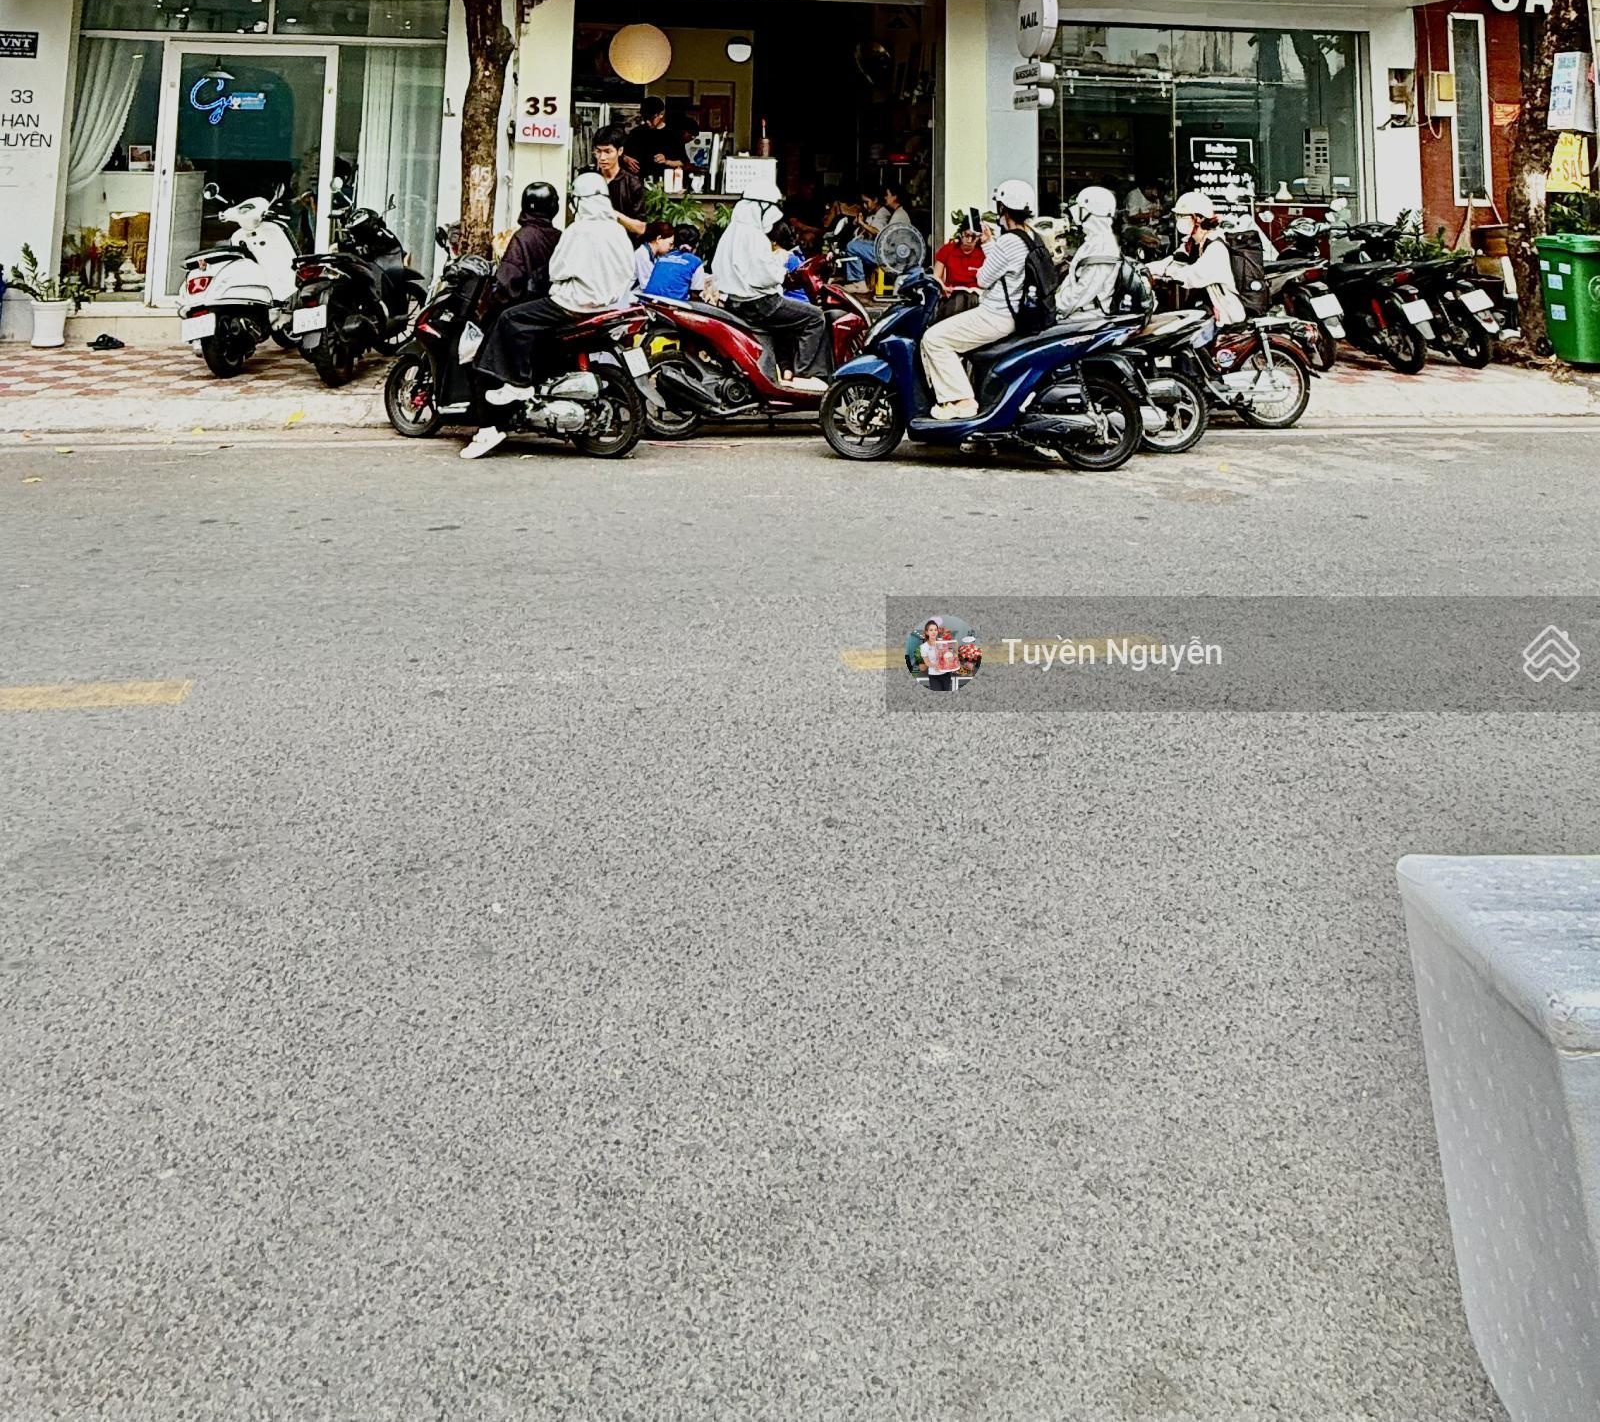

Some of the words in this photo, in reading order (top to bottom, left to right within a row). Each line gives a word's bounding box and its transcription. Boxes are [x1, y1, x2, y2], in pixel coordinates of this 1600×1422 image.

[1020, 11, 1039, 31] NAIL
[11, 89, 34, 104] 33
[525, 96, 558, 116] 35
